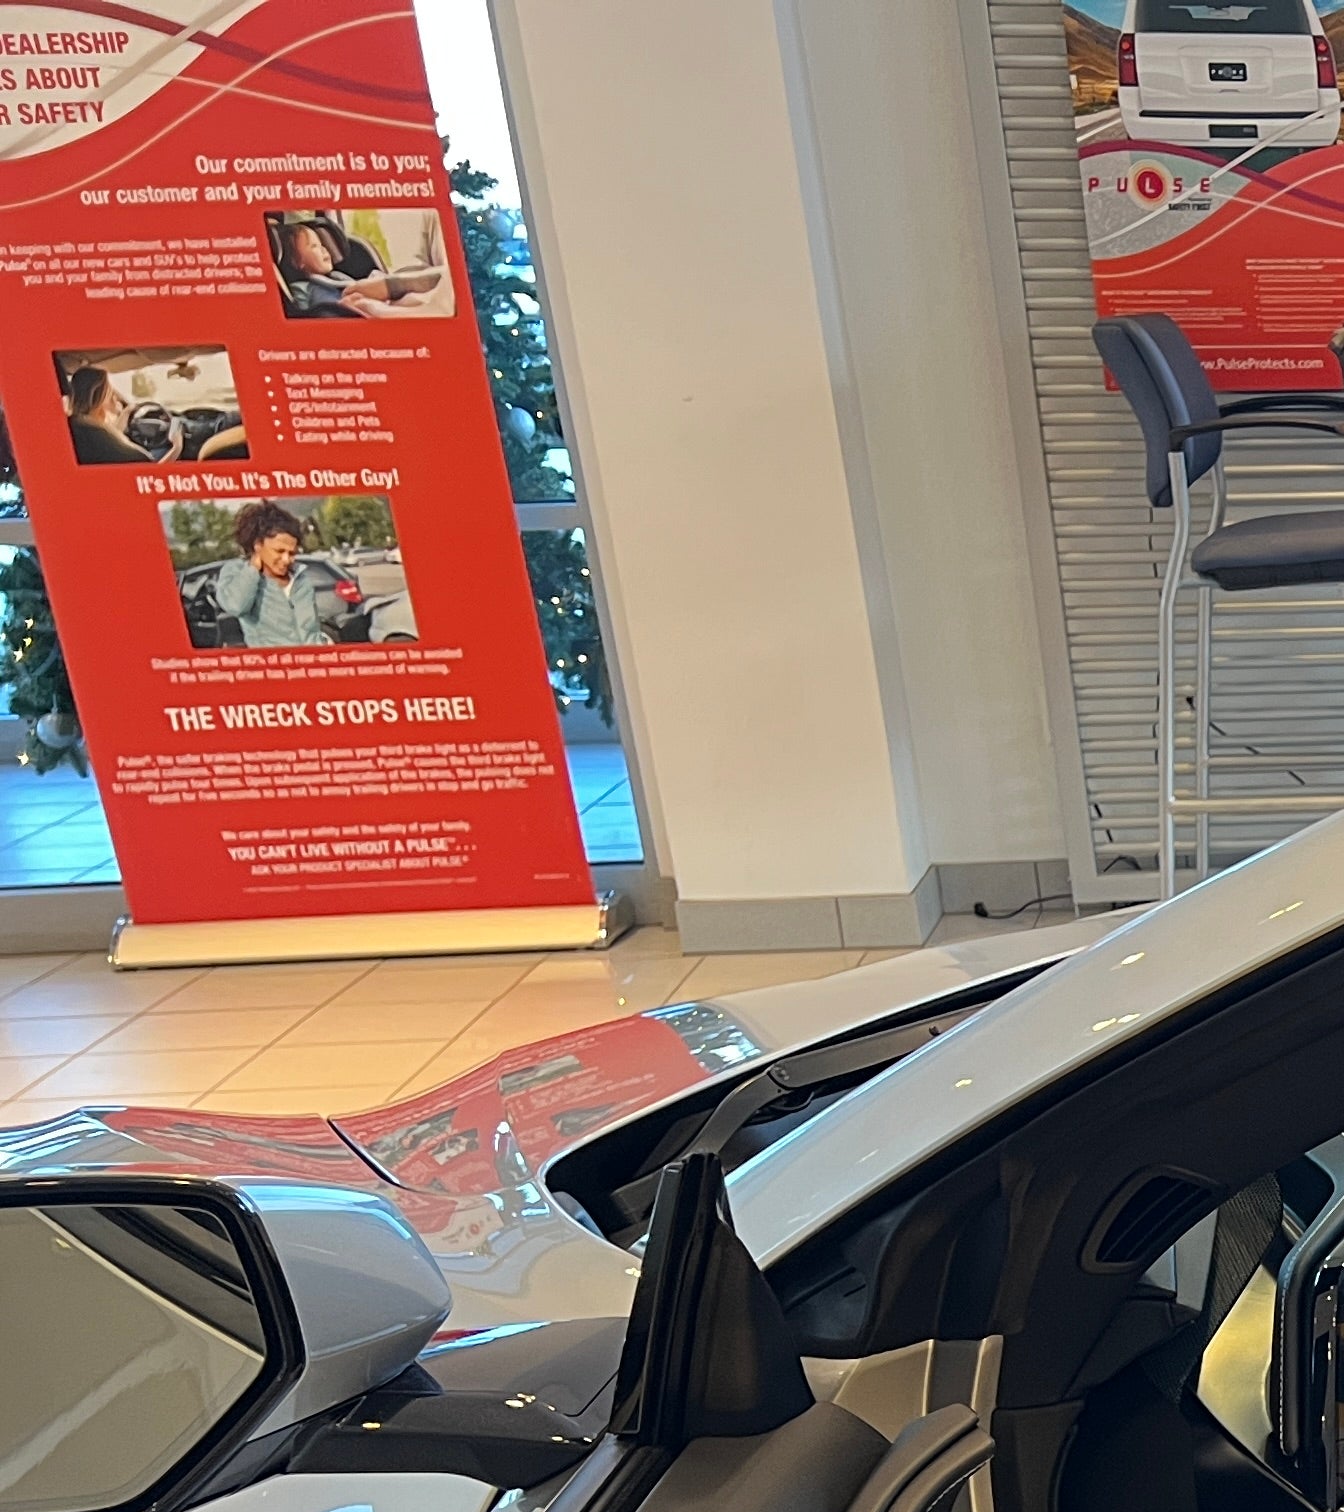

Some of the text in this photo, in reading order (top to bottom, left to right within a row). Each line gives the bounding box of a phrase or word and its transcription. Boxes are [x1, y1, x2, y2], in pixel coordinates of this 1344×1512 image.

[0, 32, 129, 55] EALERSHIP
[26, 67, 100, 90] ABOUT
[17, 101, 104, 125] SAFETY
[195, 152, 431, 174] Our commitment is to you;
[80, 179, 435, 205] our customer and your family members!
[136, 467, 400, 494] It's Not You. It's The Other Guy!
[164, 696, 476, 731] THE WRECK STOPS HERE!
[227, 846, 256, 861] YOU
[258, 844, 297, 859] CAN'T
[299, 843, 330, 858] LIVE
[331, 840, 389, 856] WITHOUT
[394, 839, 405, 853] A
